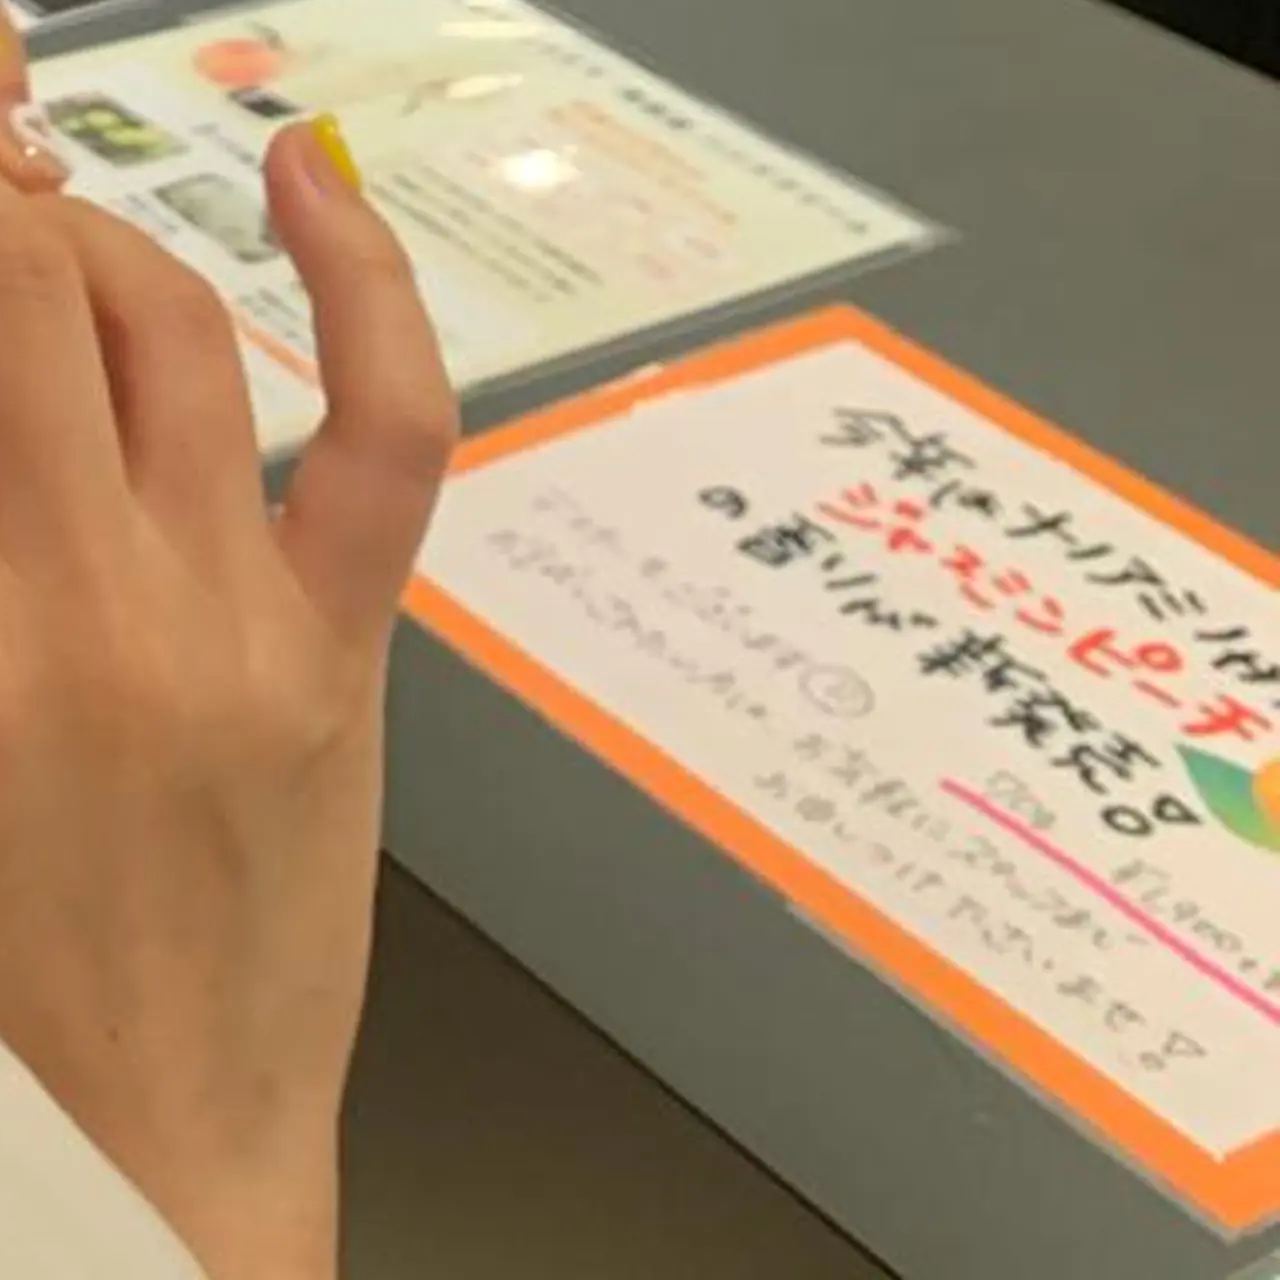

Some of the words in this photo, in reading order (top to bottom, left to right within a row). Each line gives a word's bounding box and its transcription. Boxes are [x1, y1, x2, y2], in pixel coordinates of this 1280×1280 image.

[813, 481, 1274, 742] ジャスミンピーチ
